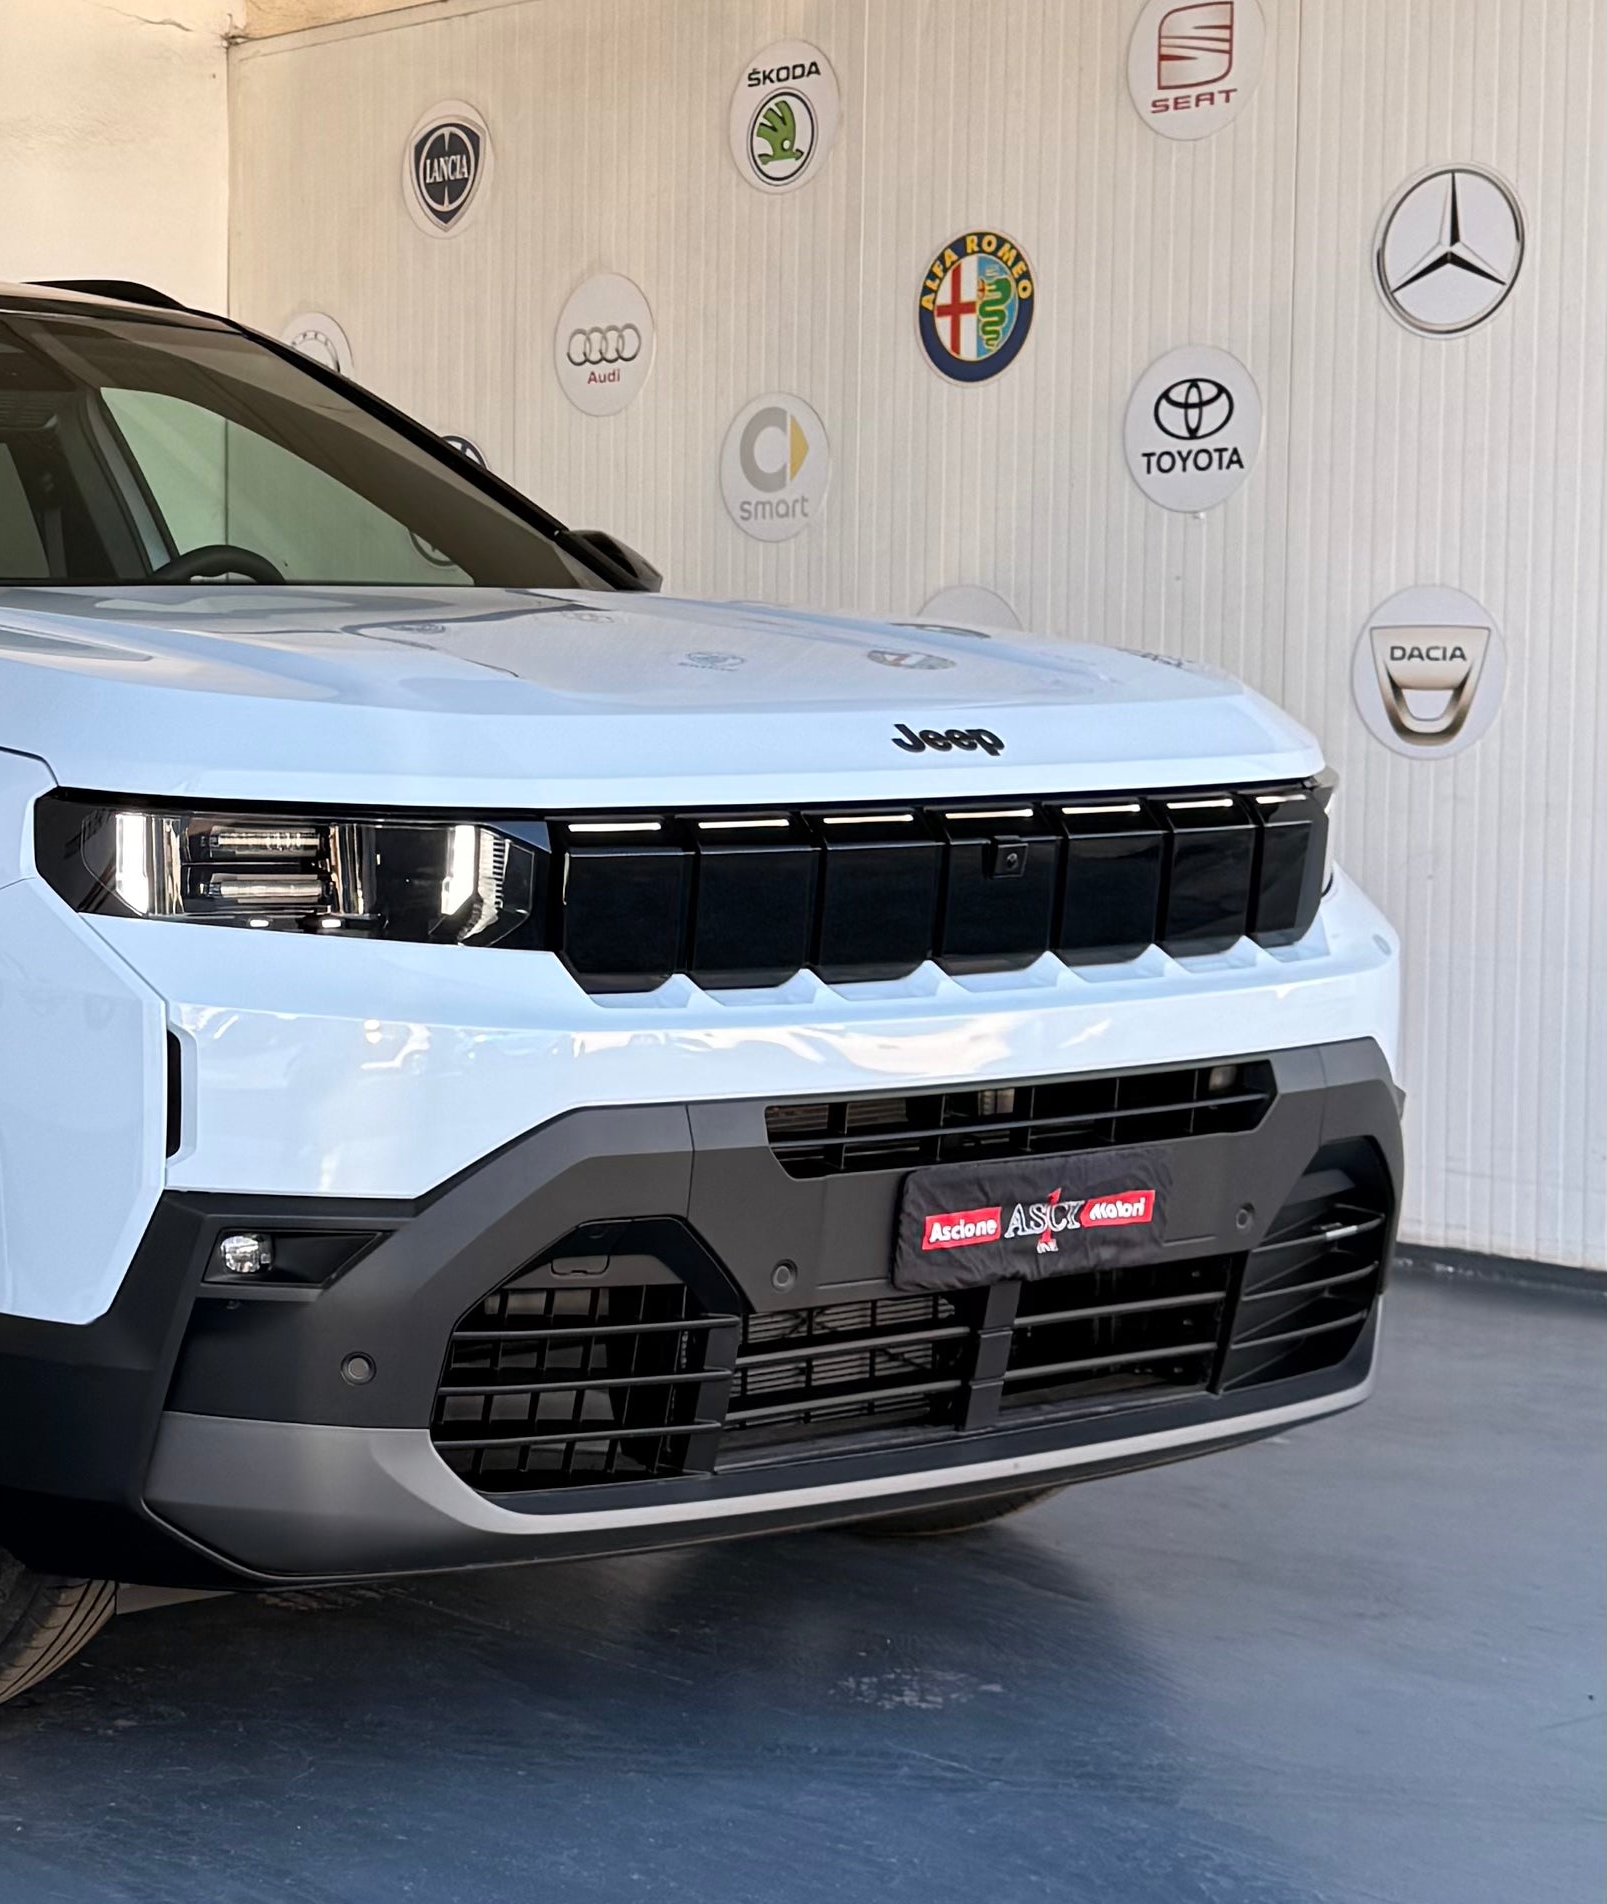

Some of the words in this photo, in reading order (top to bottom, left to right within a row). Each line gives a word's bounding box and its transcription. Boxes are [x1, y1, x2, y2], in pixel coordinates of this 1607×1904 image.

[747, 60, 822, 88] ŠKODA
[1151, 87, 1238, 114] SEAT
[425, 154, 469, 184] LANCIA
[921, 248, 958, 312] ALFA
[965, 234, 1033, 300] ROMEO
[587, 368, 621, 385] Audi
[1141, 446, 1245, 475] TOYOTA
[739, 494, 809, 521] smart
[1389, 645, 1467, 662] DACIA
[891, 723, 1005, 756] Jeep
[929, 1217, 998, 1243] Ascione
[1089, 1198, 1146, 1221] Motori
